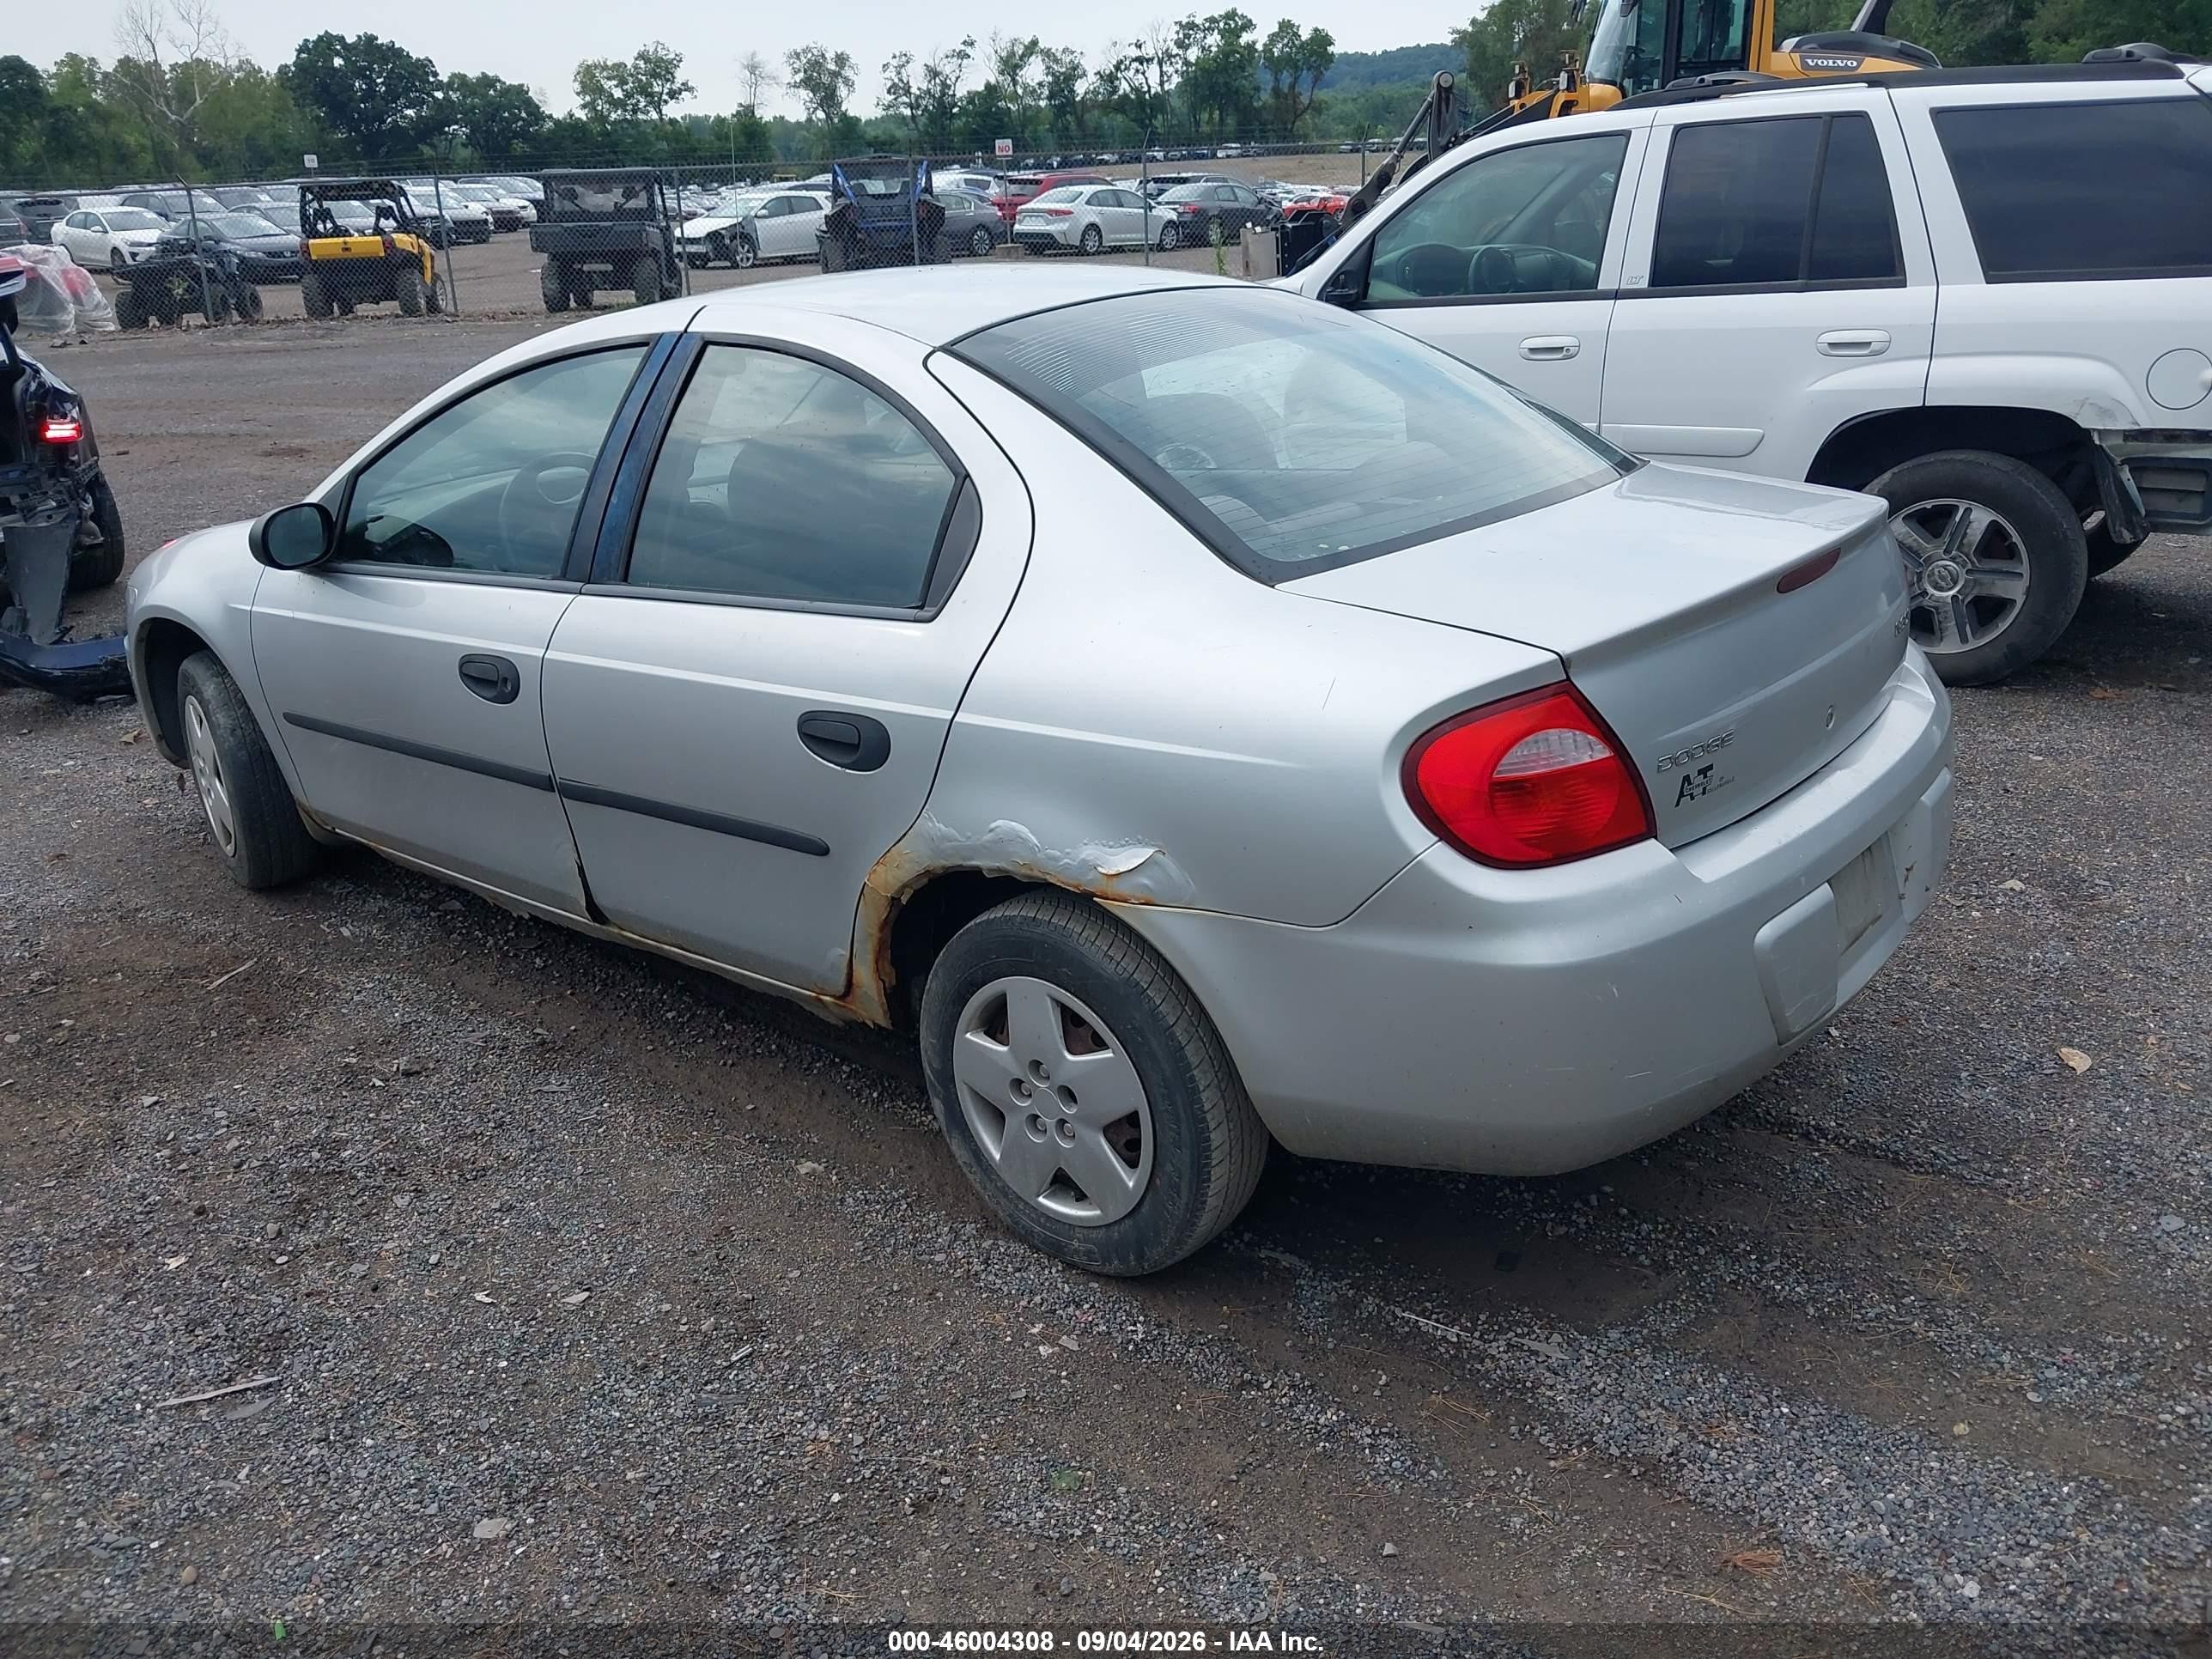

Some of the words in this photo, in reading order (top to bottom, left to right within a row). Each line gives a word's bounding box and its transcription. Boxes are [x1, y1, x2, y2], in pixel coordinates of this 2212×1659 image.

[1804, 58, 1857, 67] VOLVO
[1627, 275, 1644, 285] LT
[1657, 729, 1735, 774] DODGE
